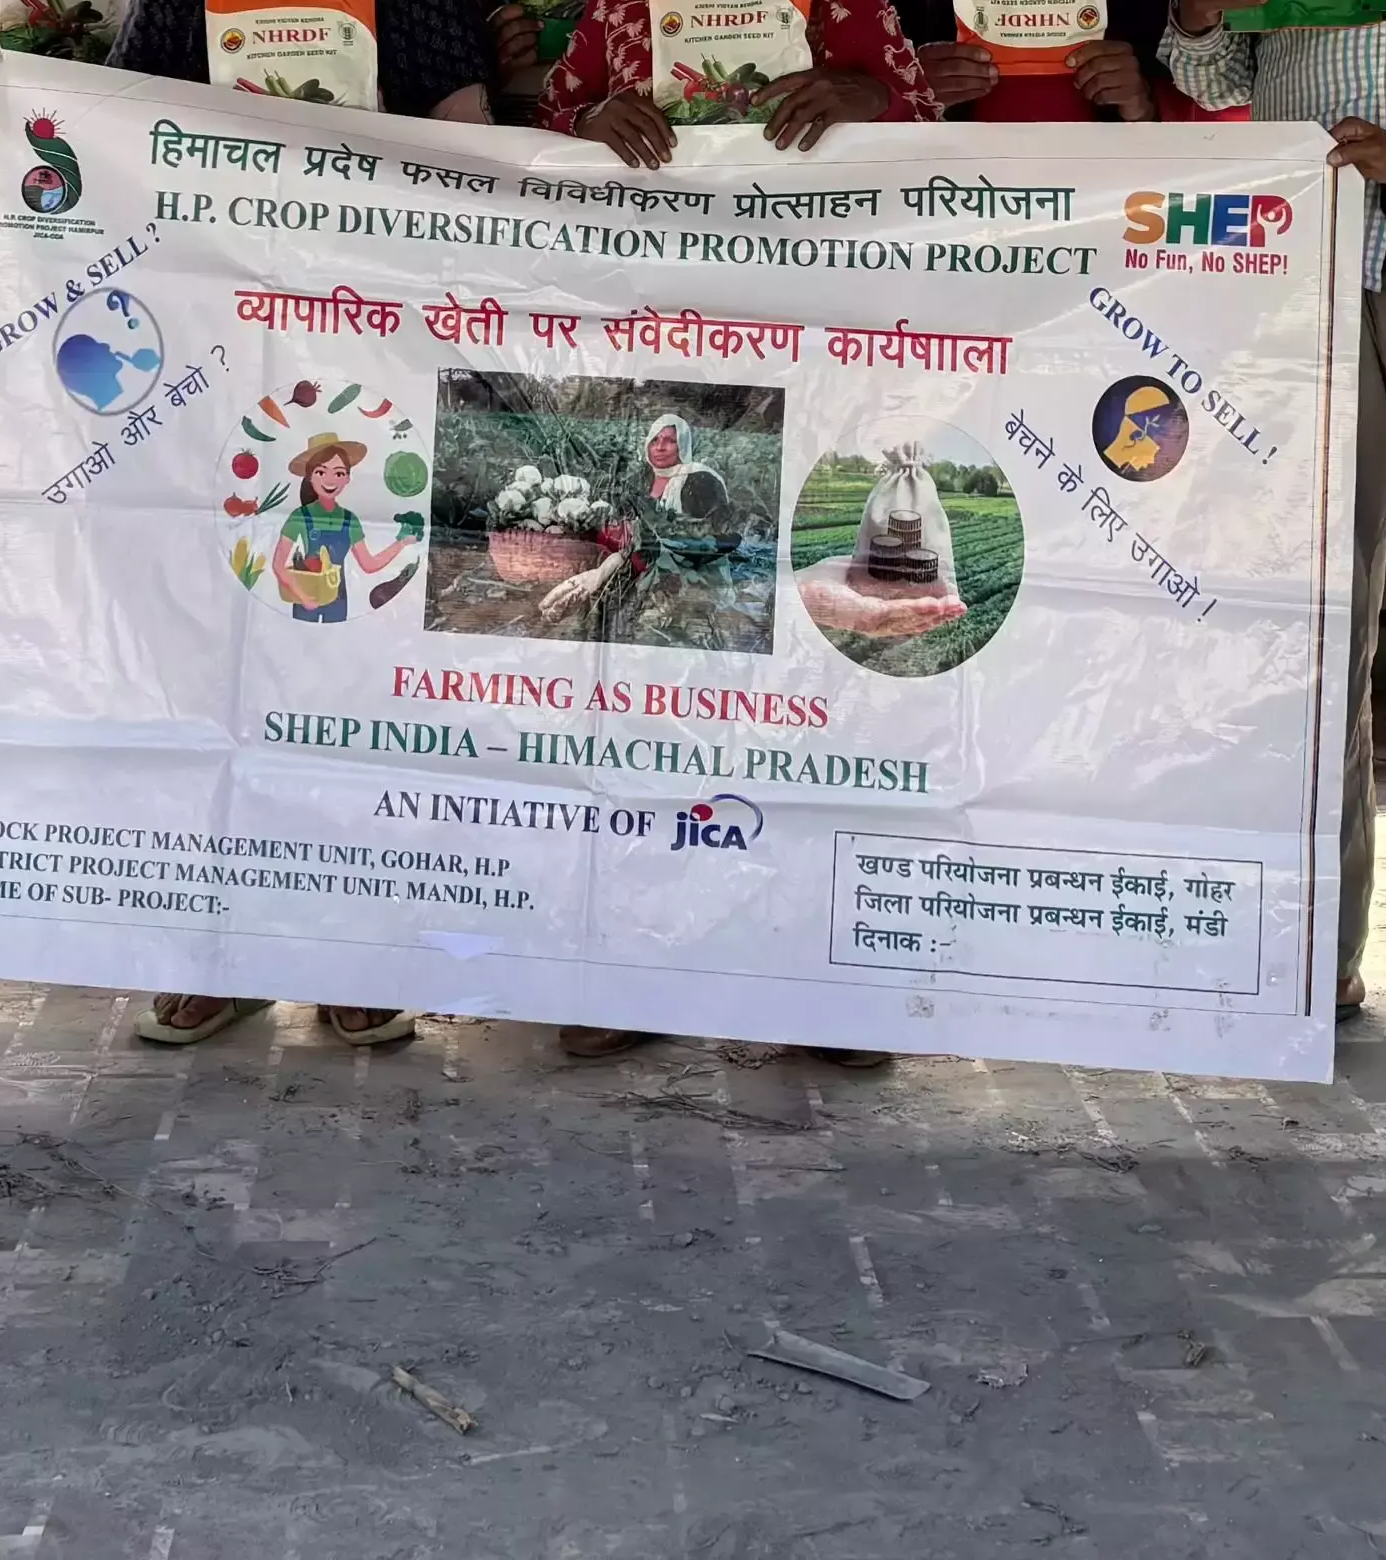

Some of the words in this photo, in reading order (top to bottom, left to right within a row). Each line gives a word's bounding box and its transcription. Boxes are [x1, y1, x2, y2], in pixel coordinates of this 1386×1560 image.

[252, 28, 331, 44] NHRDF
[685, 35, 712, 43] KITCHEN
[690, 11, 769, 28] NHRDF
[994, 12, 1070, 27] NHRDF
[149, 119, 286, 174] हिमाचल
[401, 160, 500, 194] फसल
[518, 177, 716, 214] विविधीकरण
[733, 182, 882, 219] प्रोत्साहन
[901, 174, 1075, 220] परियोजना
[155, 190, 217, 223] H.P.
[228, 196, 330, 231] CROP
[338, 204, 667, 260] DIVERSIFICATION
[677, 232, 913, 271] PROMOTION
[925, 242, 1097, 276] PROJECT
[1123, 191, 1293, 248] SHEP
[65, 279, 86, 303] &
[86, 236, 149, 286] SELL
[1124, 249, 1150, 270] No
[1155, 249, 1193, 274] Fun,
[1201, 251, 1225, 272] No
[1233, 253, 1288, 275] SHEP!
[234, 284, 403, 338] व्यापारिक
[422, 291, 509, 348] खेती
[529, 313, 581, 349] पर
[600, 305, 805, 362] संवेदीकरण
[1089, 287, 1170, 360] GROW
[1165, 354, 1203, 394] TO
[1201, 389, 1266, 456] SELL
[41, 440, 116, 505] उगाओ
[120, 405, 163, 447] और
[163, 364, 210, 408] बेचो
[1005, 408, 1056, 469] बेचने
[1057, 462, 1084, 493] के
[1081, 486, 1128, 542] लिए
[1130, 532, 1200, 608] उगाओ
[391, 665, 574, 710] FARMING
[584, 679, 632, 714] AS
[644, 683, 829, 728] BUSINESS
[264, 710, 362, 748] SHEP
[369, 719, 480, 759] INDIA
[517, 731, 735, 779] HIMACHAL
[742, 746, 932, 794] PRADESH
[373, 790, 422, 819] AN
[429, 793, 601, 834] INTIATIVE
[609, 808, 656, 838] OF
[44, 823, 146, 848] PROJECT
[151, 831, 313, 862] MANAGEMENT
[318, 844, 376, 870] UNIT,
[381, 849, 469, 878] GOHAR,
[27, 882, 59, 902] OF
[62, 885, 111, 905] SUB-
[117, 889, 230, 915] PROJECT:-
[69, 855, 171, 880] PROJECT
[175, 862, 337, 893] MANAGEMENT
[406, 880, 488, 910] MANDI,
[494, 888, 535, 910] H.P.
[855, 854, 913, 878] खण्ड
[919, 855, 1021, 887] परियोजना
[1027, 868, 1105, 894] प्रबन्धन
[1110, 867, 1175, 903] ईकाई,
[1183, 872, 1236, 904] गोहर
[855, 886, 912, 916] जिला
[919, 892, 1021, 925] परियोजना
[1027, 905, 1104, 930] प्रबन्धन
[1110, 906, 1175, 939] ईकाई,
[1184, 909, 1228, 938] मंडी
